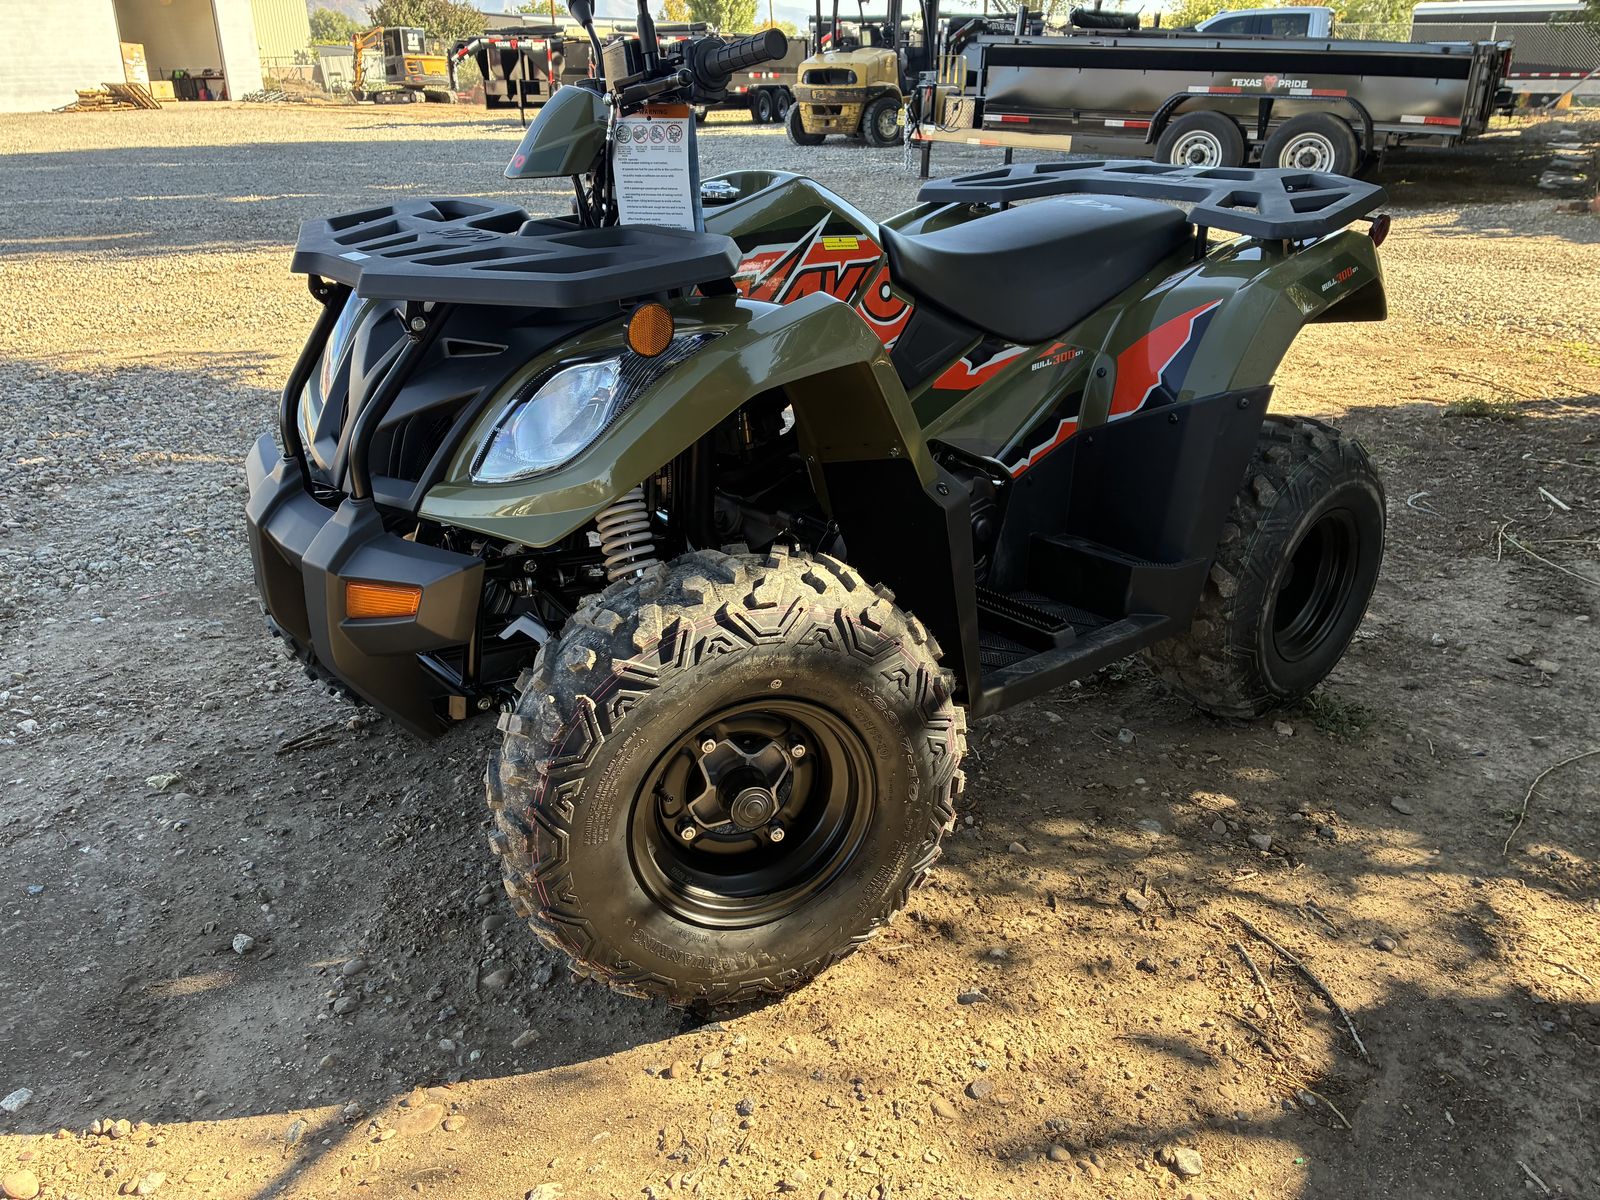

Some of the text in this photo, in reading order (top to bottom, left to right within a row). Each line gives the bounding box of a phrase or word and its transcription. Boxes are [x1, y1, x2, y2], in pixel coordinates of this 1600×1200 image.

[1231, 78, 1308, 88] TEXAS PRIDE
[1321, 278, 1338, 292] BULL
[1031, 359, 1053, 371] BULL
[1052, 349, 1076, 365] 300
